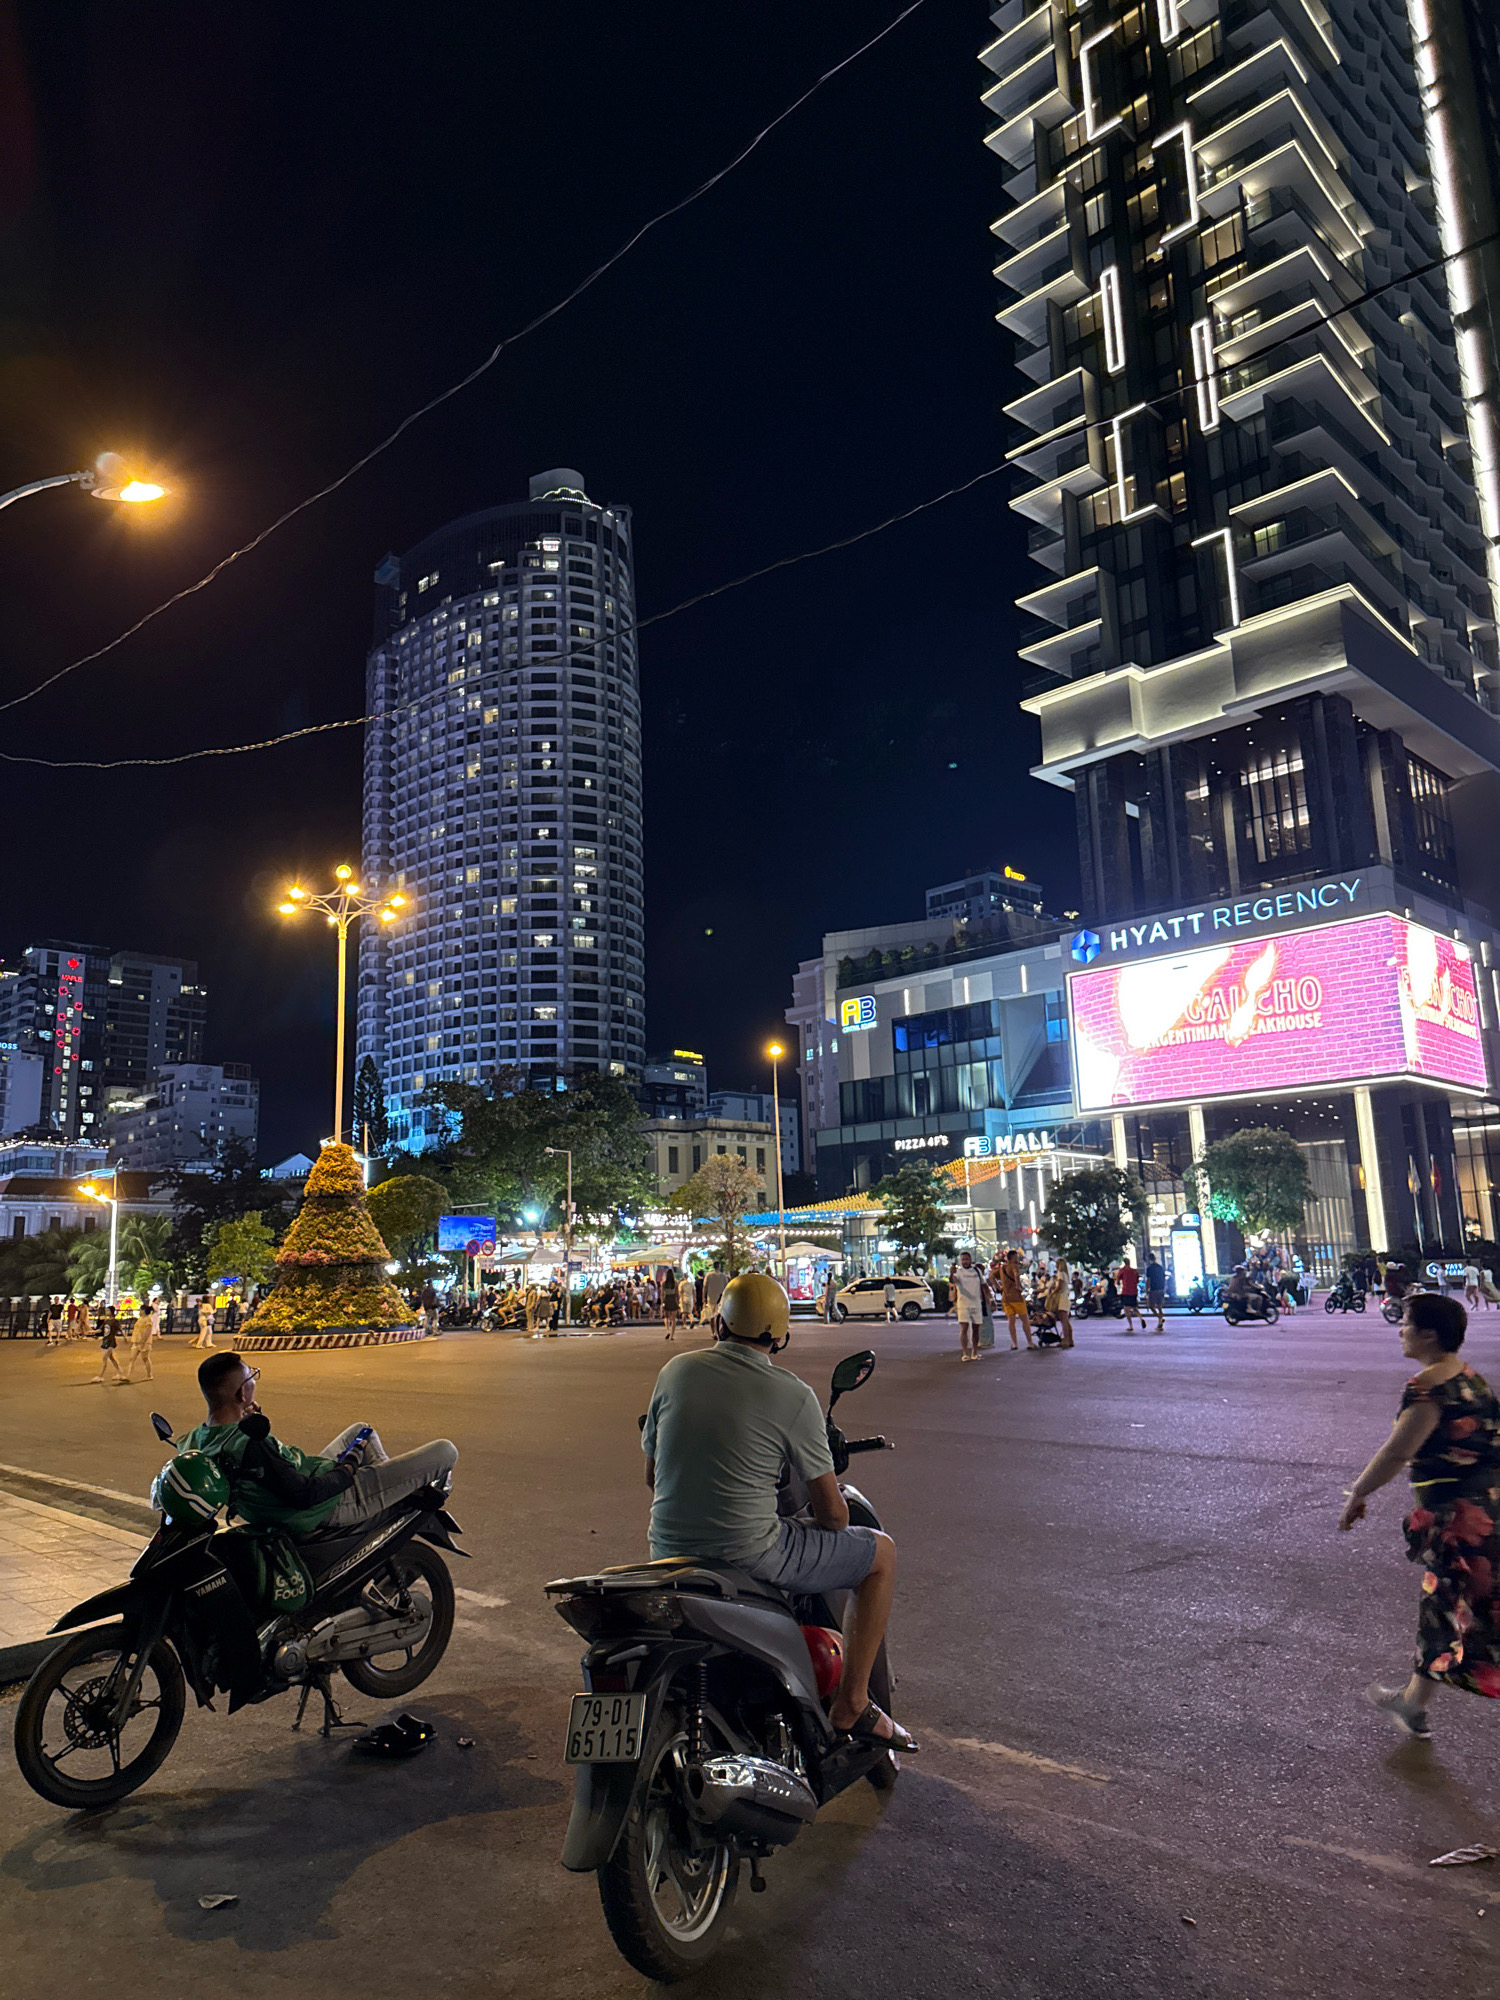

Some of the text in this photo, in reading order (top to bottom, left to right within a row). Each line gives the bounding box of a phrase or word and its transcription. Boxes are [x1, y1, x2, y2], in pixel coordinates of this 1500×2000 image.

[1110, 878, 1362, 951] HYATT REGENCY
[0, 1042, 18, 1050] OSS
[895, 1138, 926, 1151] PIZZA
[995, 1131, 1056, 1154] MALL
[195, 1576, 227, 1597] YAMAHA
[275, 1569, 303, 1588] Gab
[571, 1728, 636, 1758] 651.15
